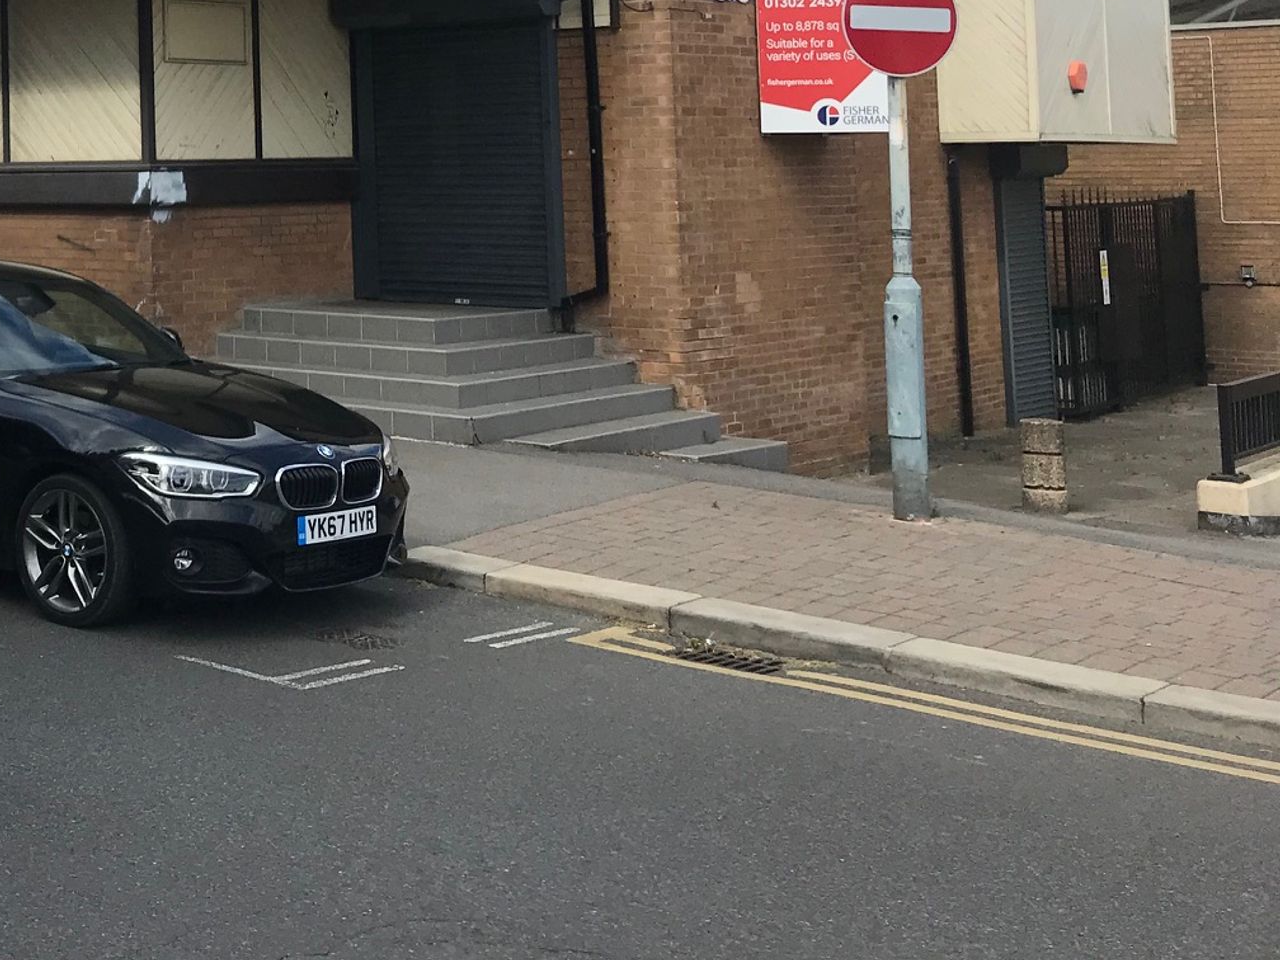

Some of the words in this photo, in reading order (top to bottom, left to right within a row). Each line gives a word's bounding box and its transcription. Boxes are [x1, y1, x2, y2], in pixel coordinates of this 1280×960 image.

[766, 22, 780, 33] Up
[783, 21, 793, 32] to
[795, 21, 824, 32] 8,878
[826, 22, 840, 33] sq
[766, 38, 808, 49] Suitable
[810, 37, 825, 49] for
[827, 40, 834, 48] a
[766, 50, 801, 63] variety
[803, 50, 815, 61] of
[816, 51, 841, 61] uses
[767, 78, 833, 88] fishergerman.co.uk
[843, 105, 880, 115] FISHER
[843, 115, 890, 125] GERMAN
[307, 514, 346, 540] YK67
[349, 509, 374, 533] HYR
